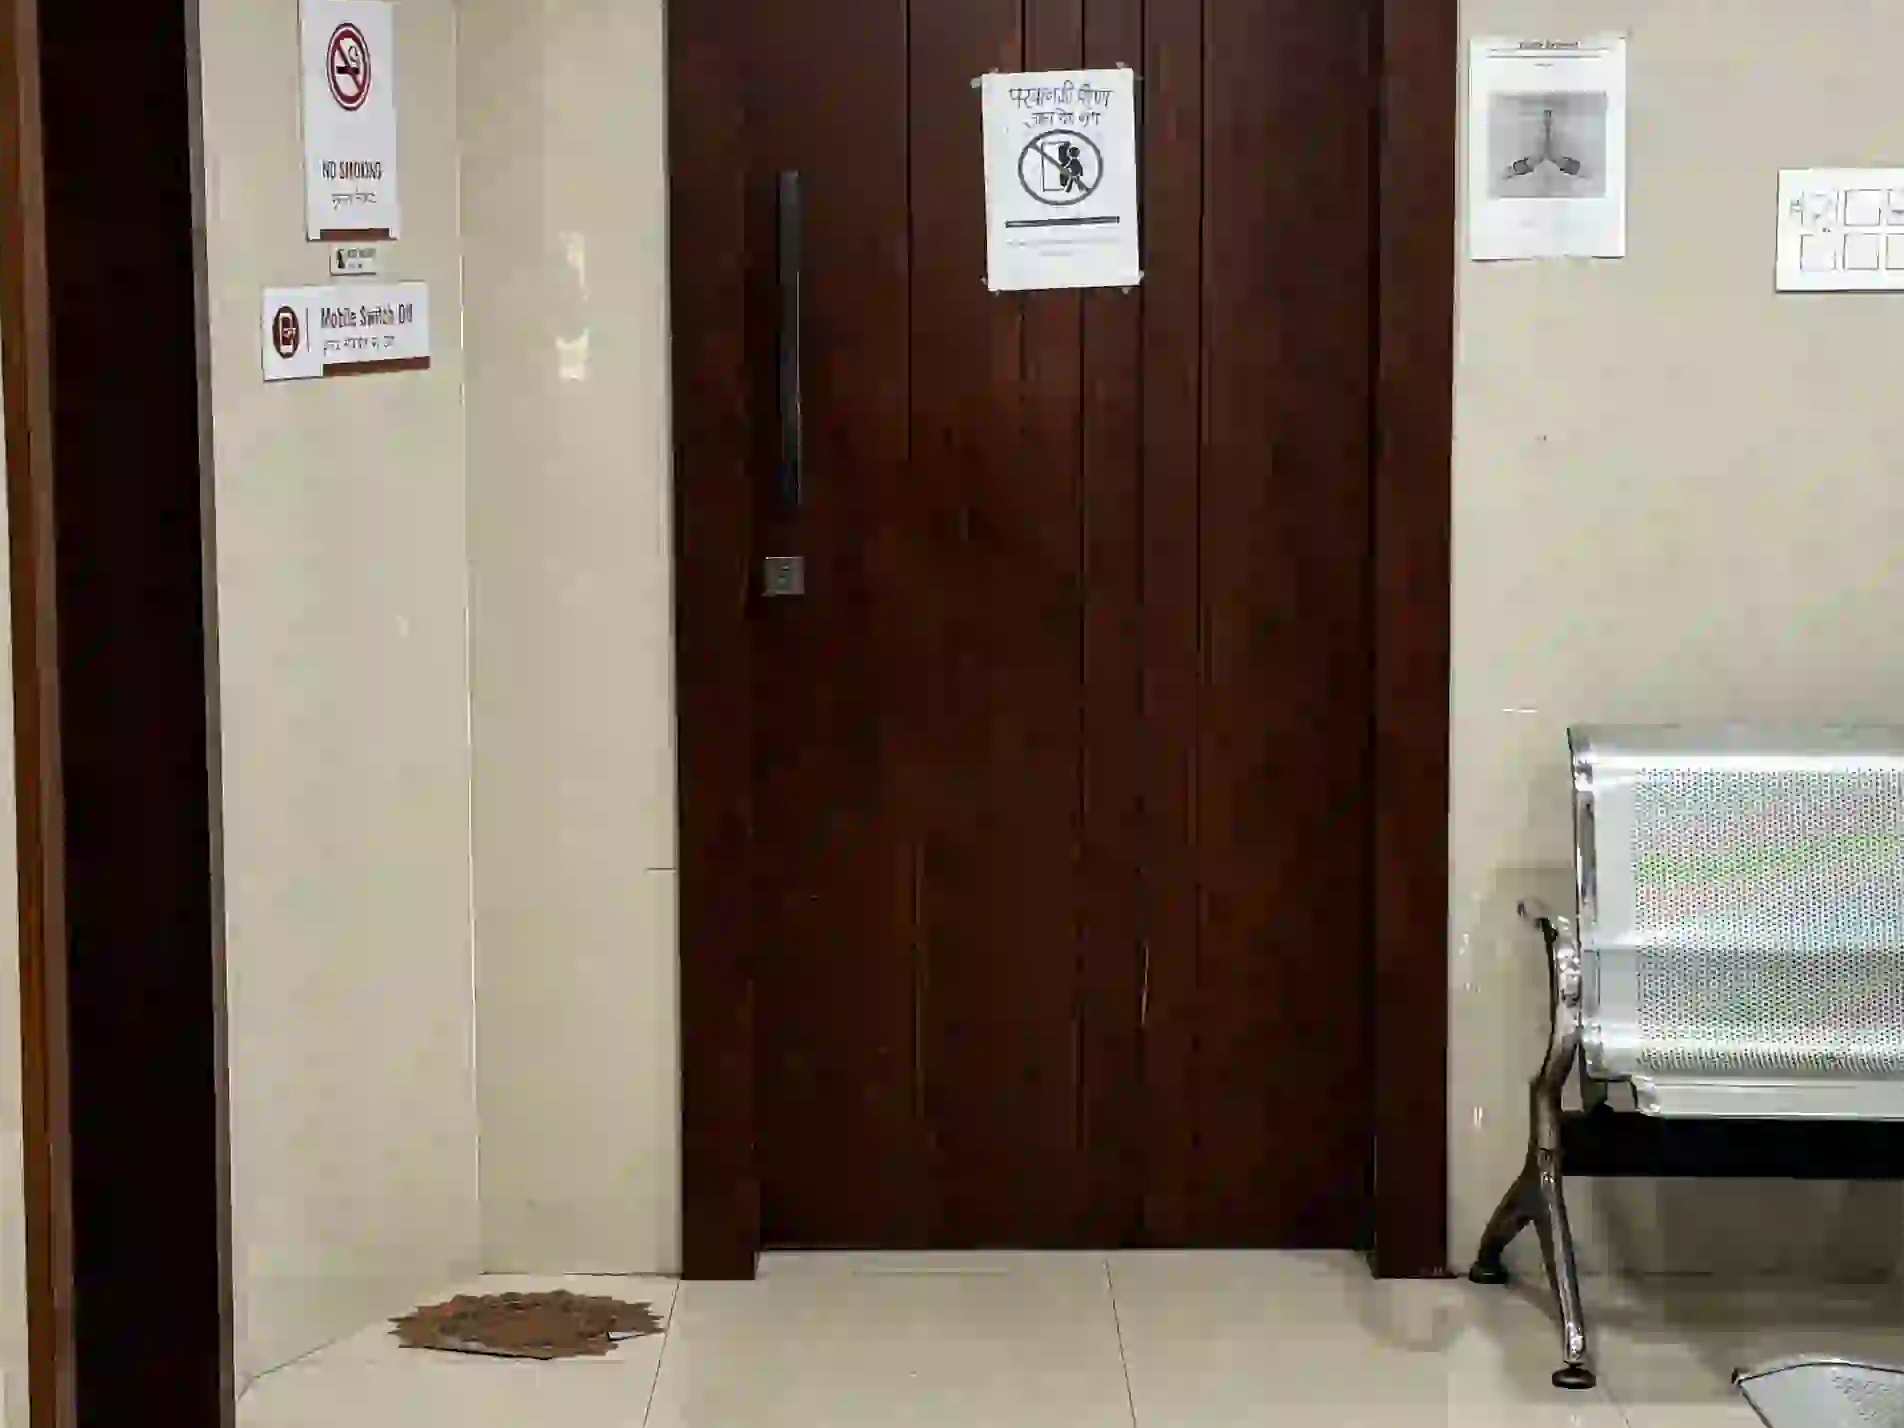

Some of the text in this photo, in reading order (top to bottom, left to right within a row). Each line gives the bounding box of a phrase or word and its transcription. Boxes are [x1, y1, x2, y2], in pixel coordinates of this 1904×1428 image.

[322, 159, 383, 181] NO SMOKING
[320, 307, 357, 329] Mobile
[359, 304, 395, 327] Switch
